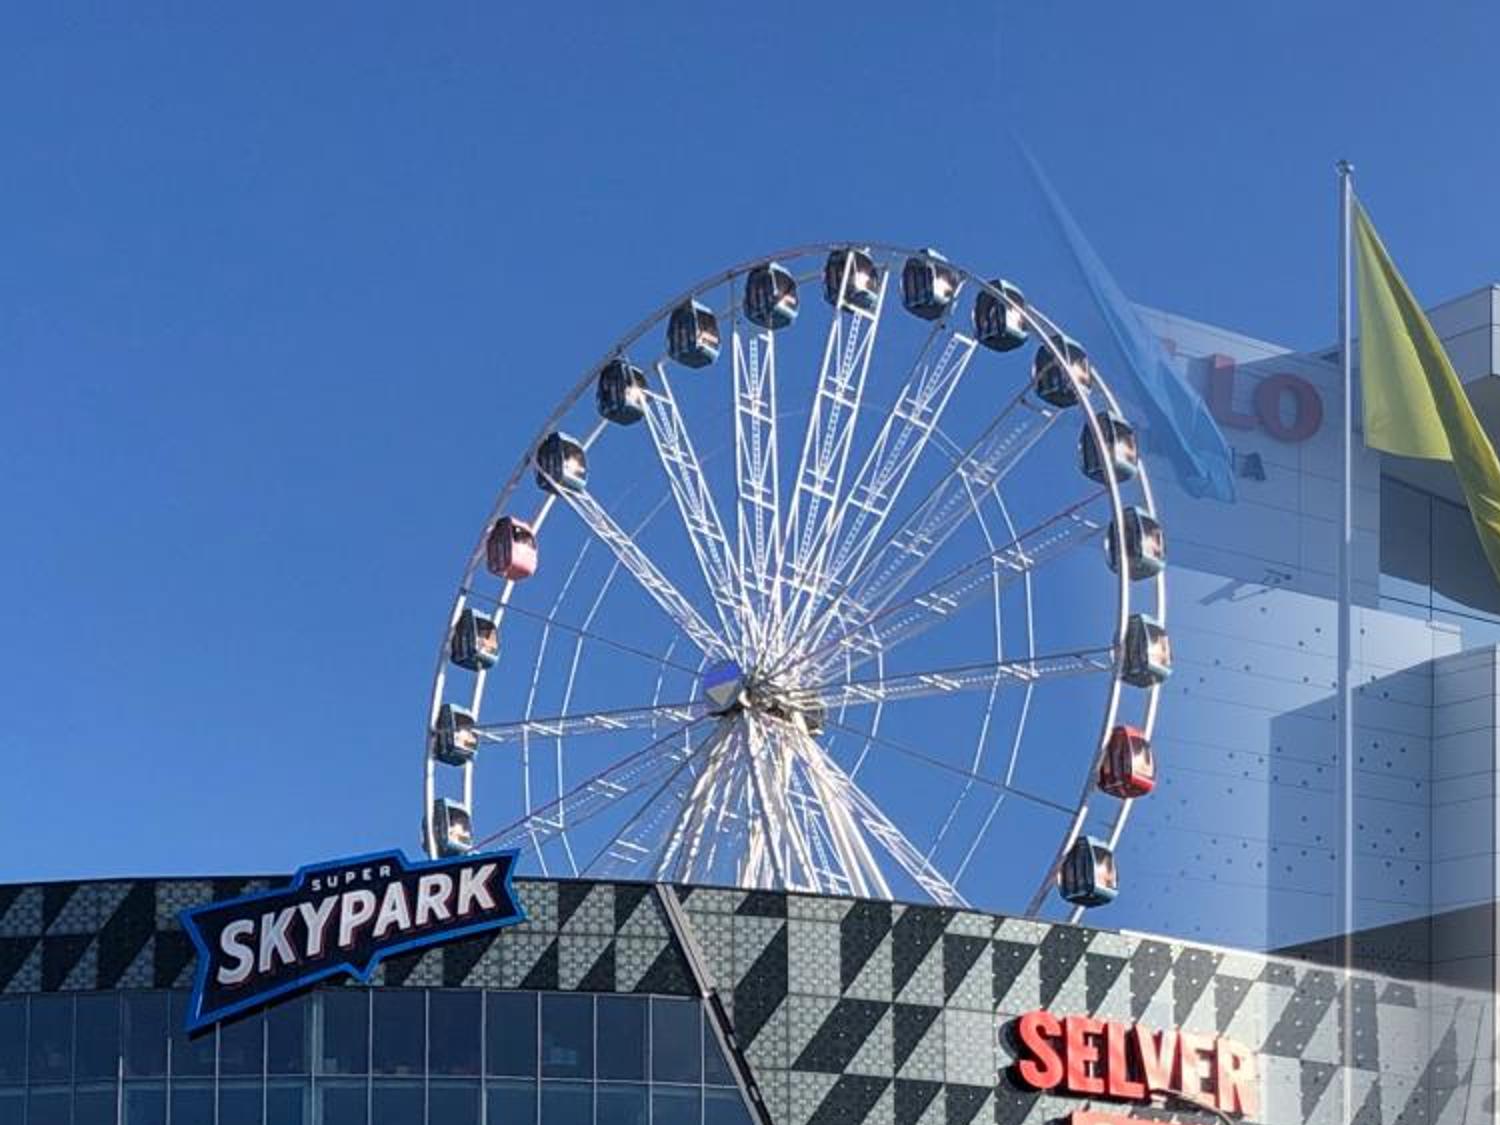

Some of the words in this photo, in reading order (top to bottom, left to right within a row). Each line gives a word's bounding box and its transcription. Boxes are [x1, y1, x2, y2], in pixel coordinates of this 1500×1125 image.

[216, 863, 497, 984] SKYPARK
[311, 865, 391, 892] SUPER
[1019, 1009, 1259, 1119] SELVER
